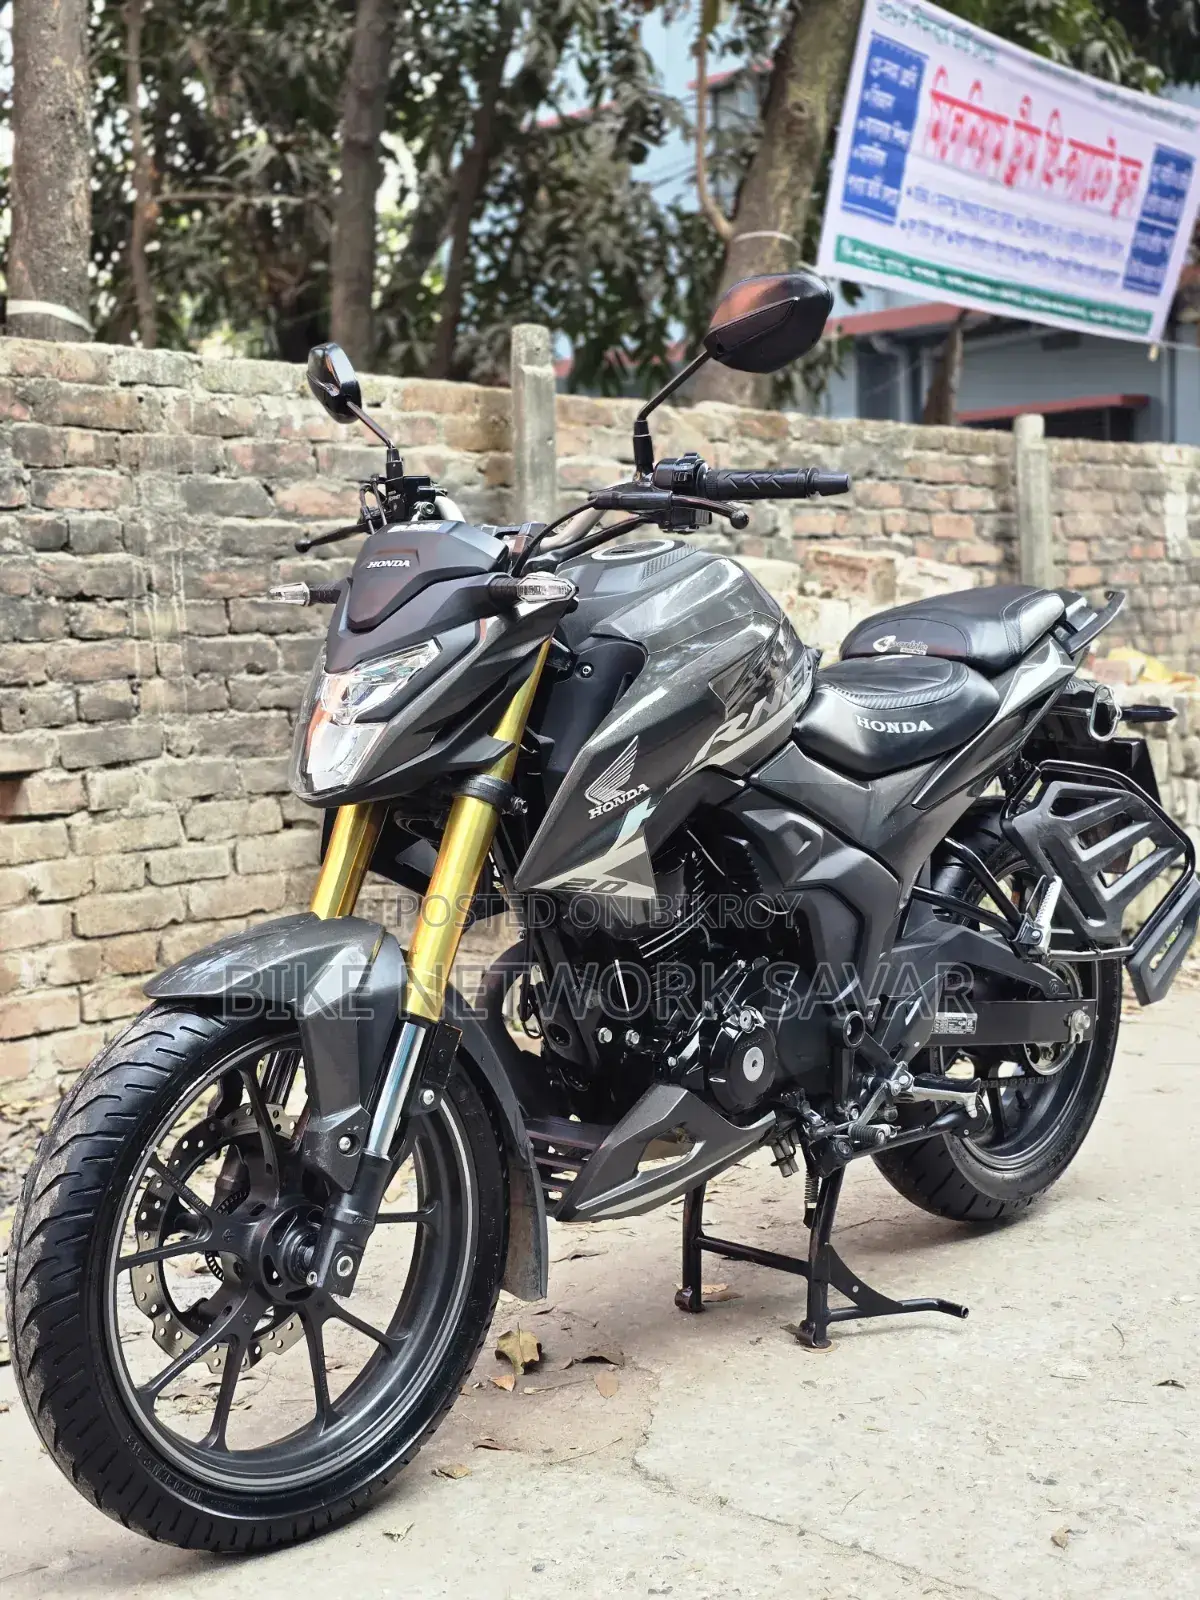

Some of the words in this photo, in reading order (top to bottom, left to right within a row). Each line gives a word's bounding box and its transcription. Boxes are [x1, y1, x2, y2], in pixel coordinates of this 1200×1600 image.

[366, 559, 411, 569] HONDA
[855, 714, 934, 734] HONDA
[587, 783, 651, 820] HONDA
